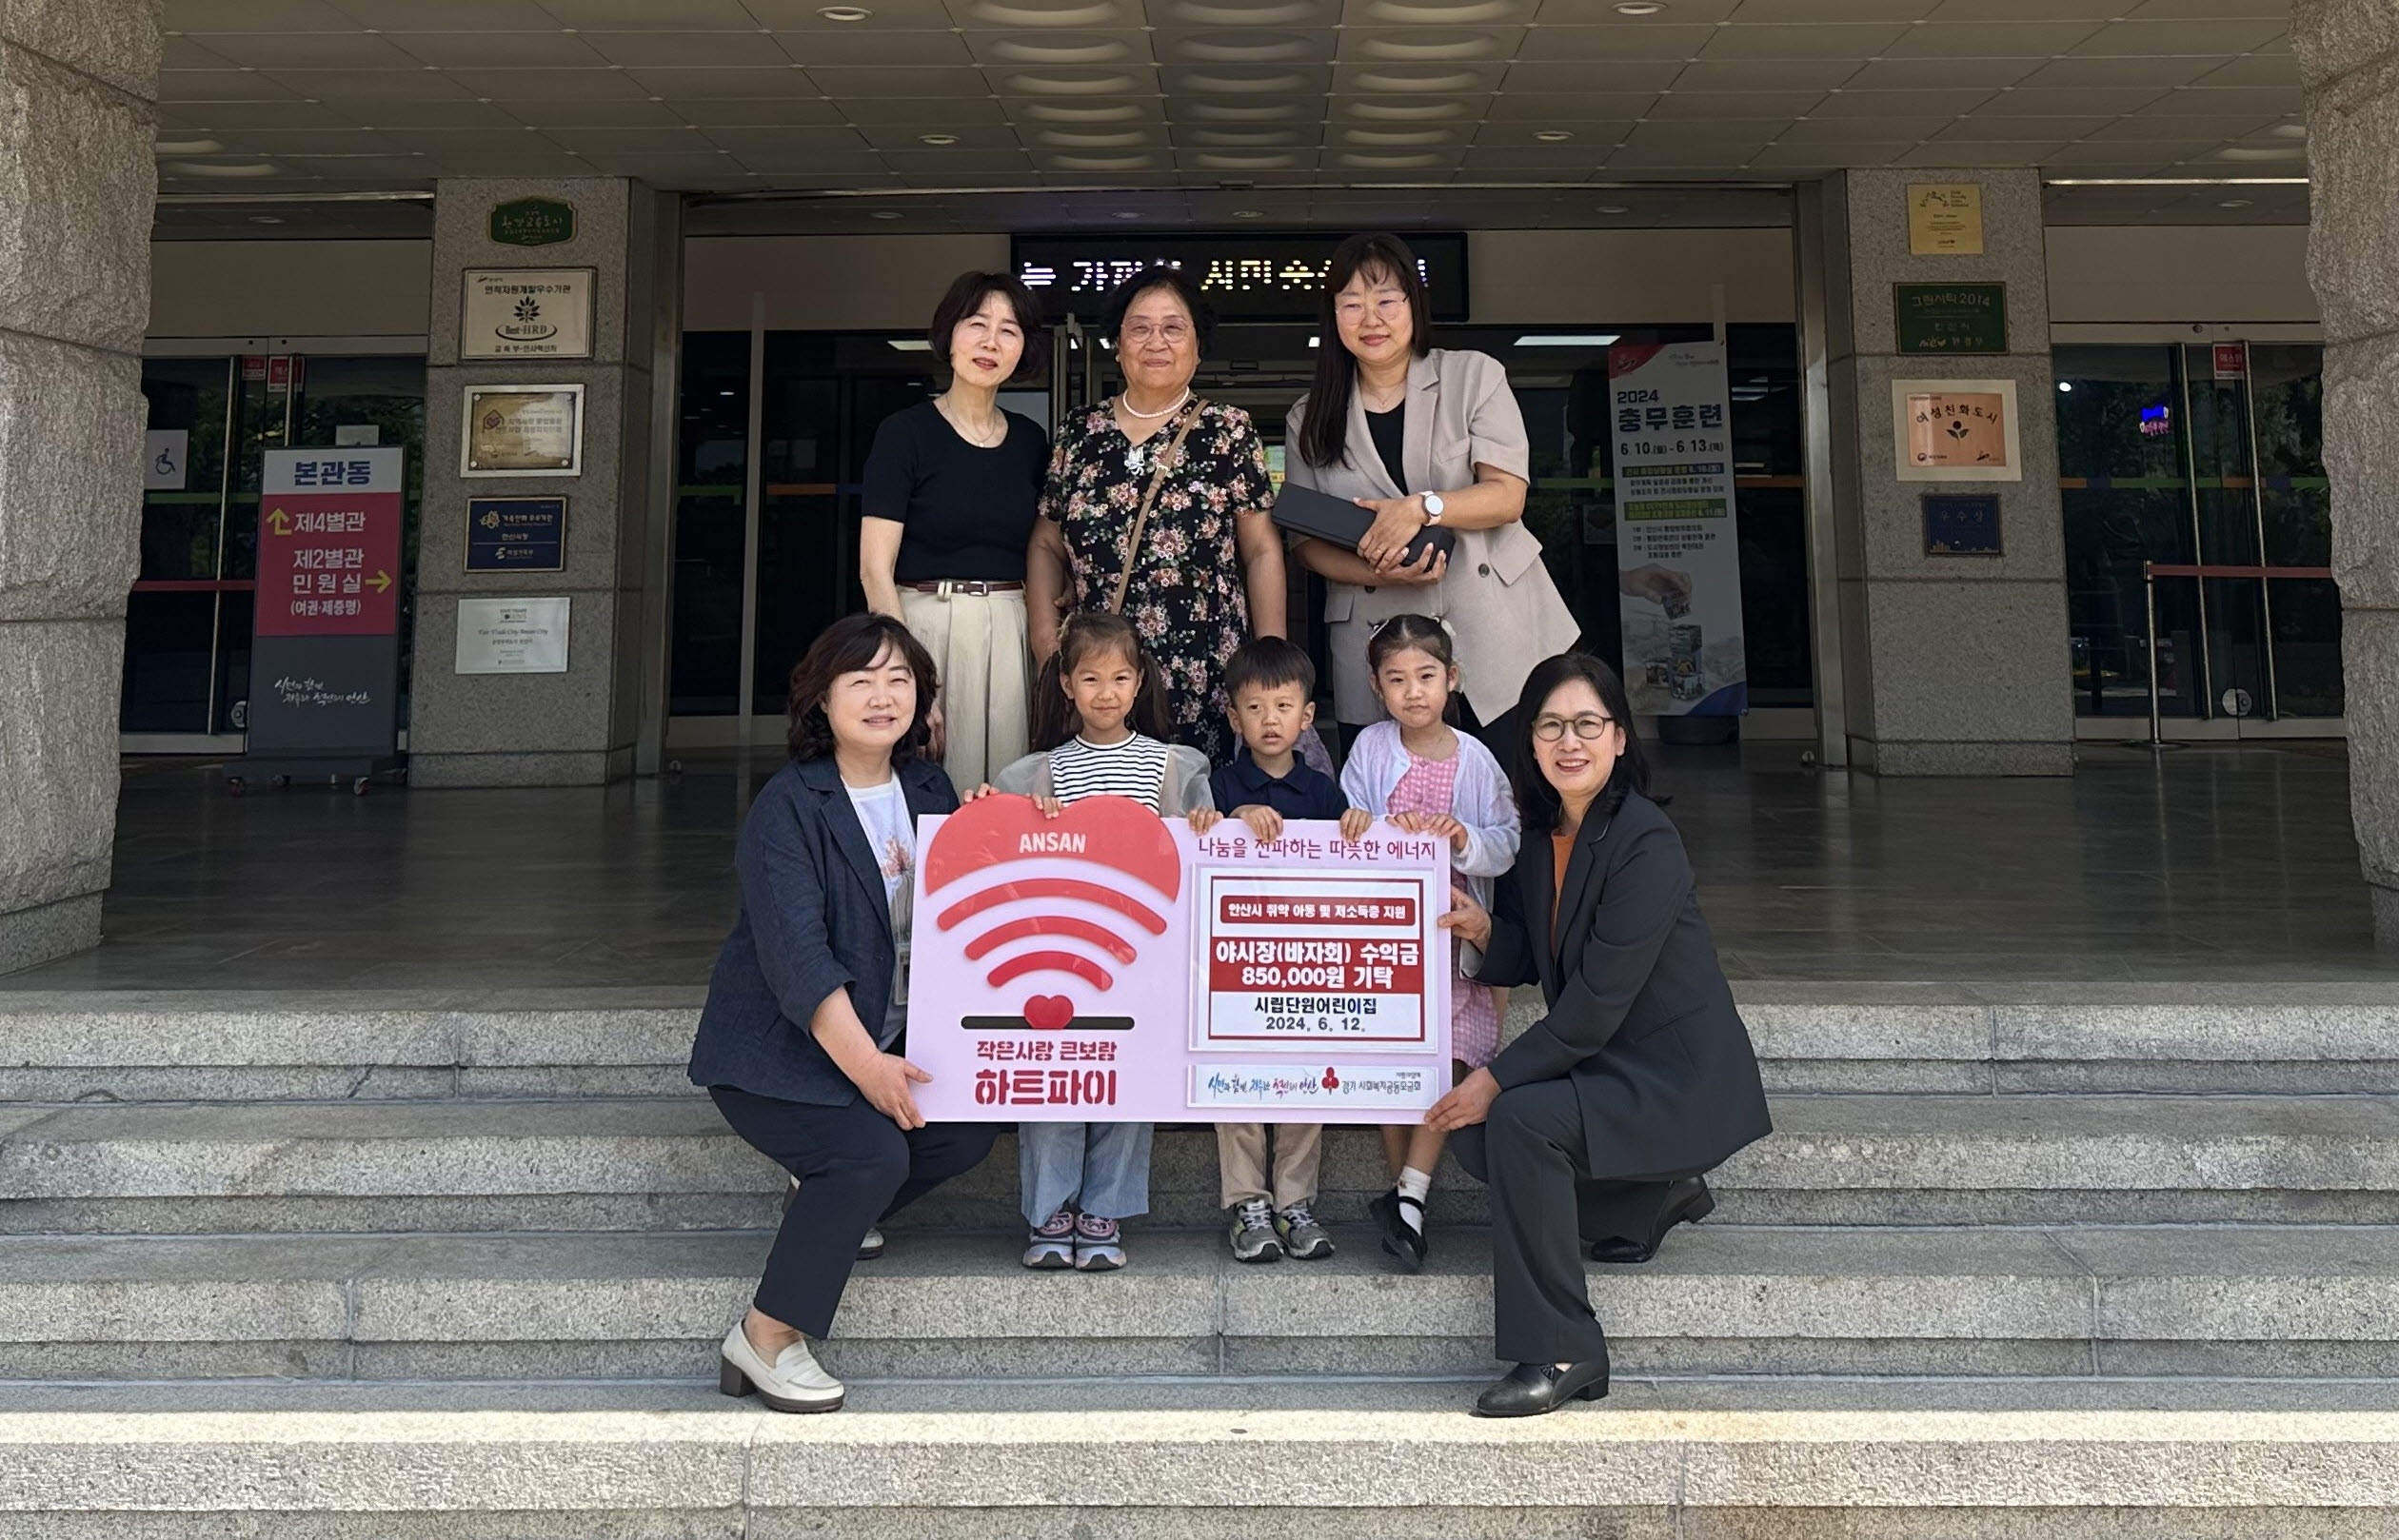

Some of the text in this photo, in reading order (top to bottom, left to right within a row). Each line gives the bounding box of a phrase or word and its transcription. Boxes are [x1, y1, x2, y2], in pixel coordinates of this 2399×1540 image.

[1617, 389, 1658, 404] 2024
[1618, 404, 1722, 432] 충무훈련
[1915, 404, 1998, 425] 여성친화도시
[294, 461, 371, 486] 본관동
[294, 511, 367, 533] 제4별관
[293, 548, 365, 569] 제2별관
[1019, 831, 1087, 854] ANSAN
[1199, 837, 1436, 861] 나눔을 전파하는 따뜻한 에너지
[1227, 903, 1262, 917] 안산시
[1266, 903, 1289, 918] 취약
[1293, 904, 1316, 918] 아동
[1319, 904, 1331, 918] 및
[1383, 905, 1406, 918] 지원
[1215, 940, 1420, 966] 야시장(바자회) 수익금
[1240, 965, 1395, 990] 850,000원 기탁
[1254, 997, 1378, 1015] 시립단원어린이집
[1265, 1016, 1366, 1033] 2024. 6. 12.
[977, 1040, 1118, 1062] 작은사랑 큰보람
[975, 1069, 1117, 1106] 하트파이
[1358, 1080, 1421, 1096] 사회복지공동모금회
